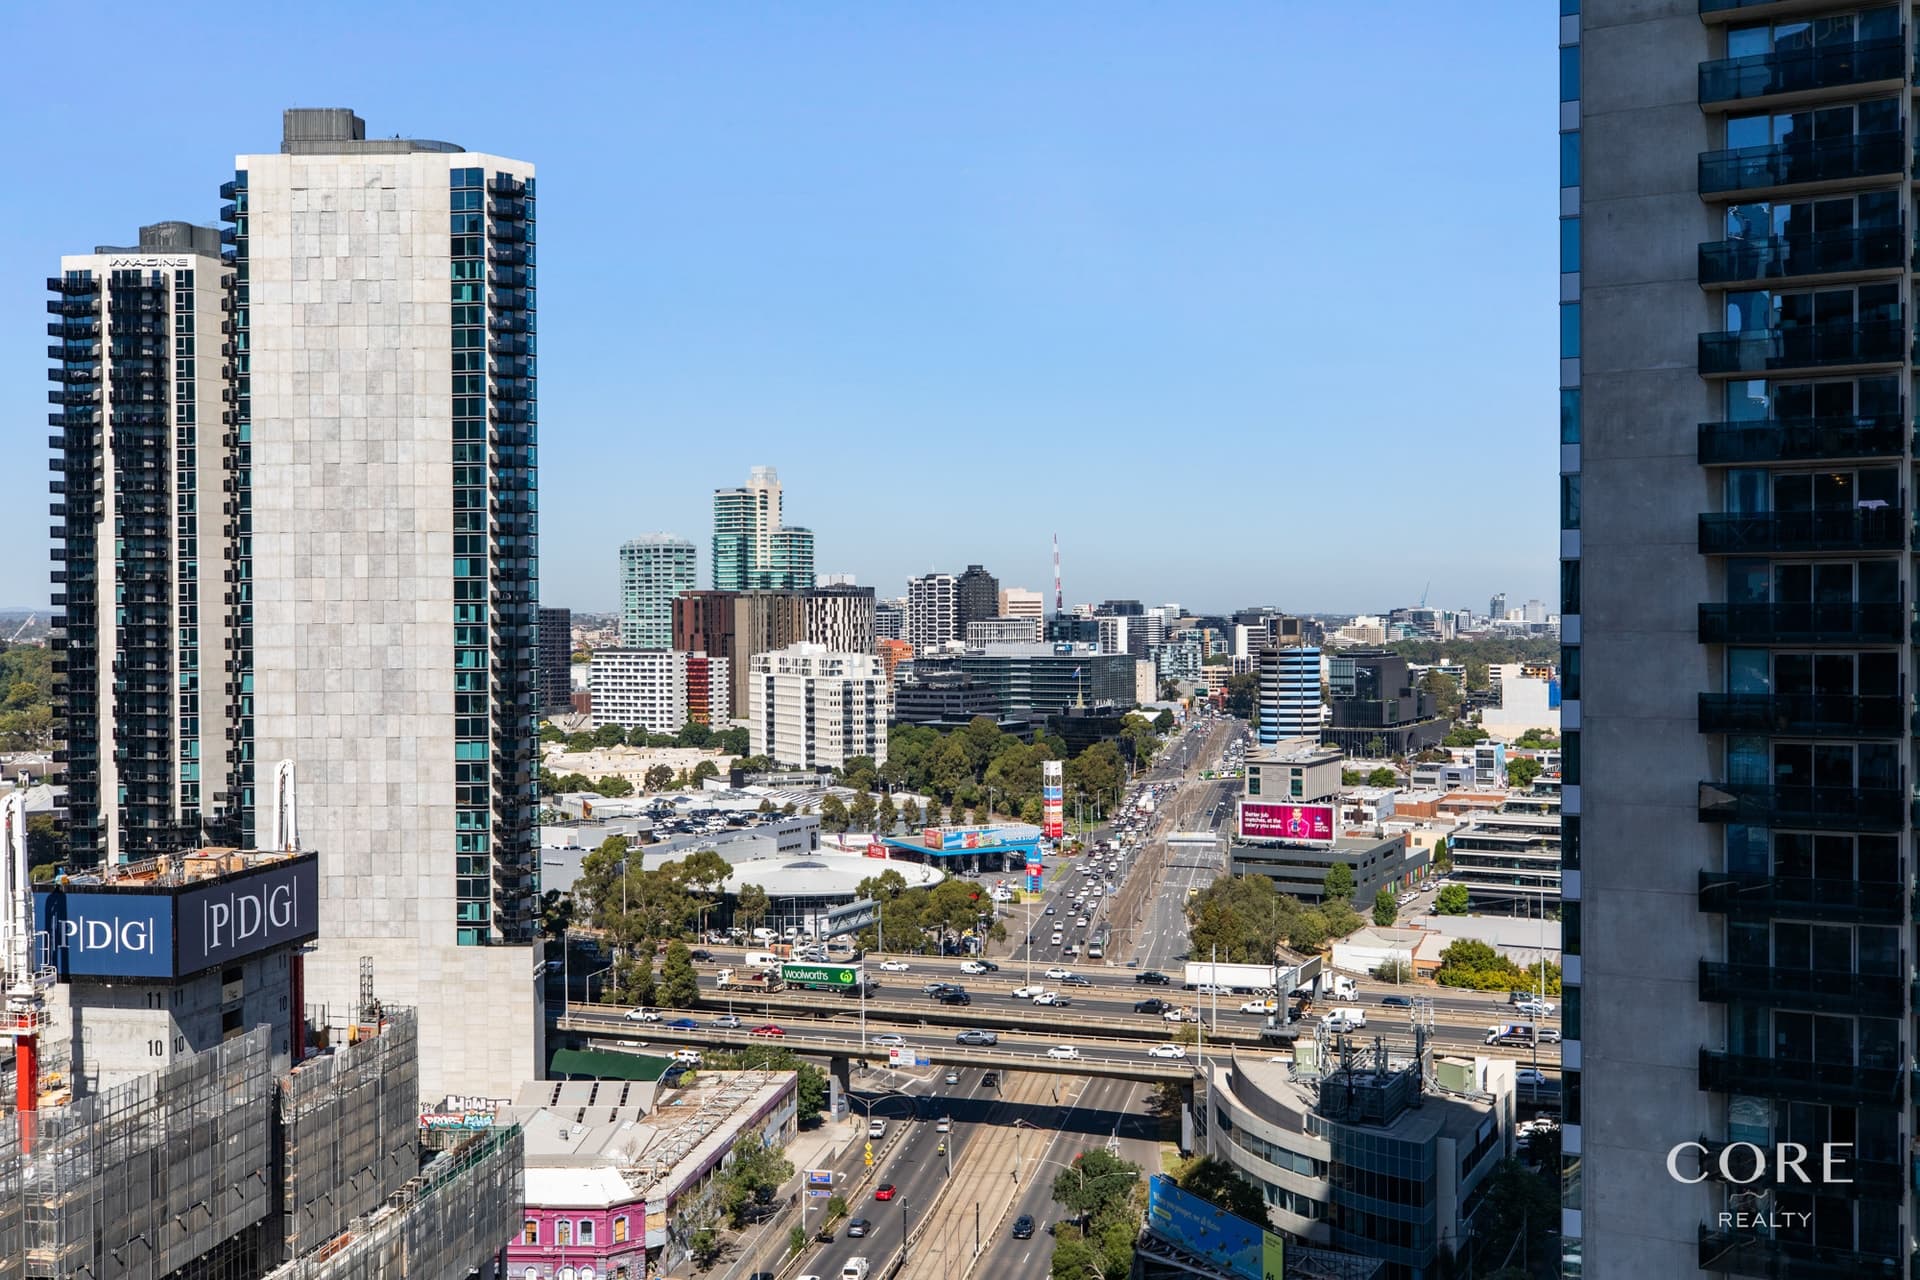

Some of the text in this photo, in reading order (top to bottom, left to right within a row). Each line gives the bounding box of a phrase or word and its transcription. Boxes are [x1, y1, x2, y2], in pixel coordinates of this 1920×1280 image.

[784, 969, 829, 980] Woolworths
[147, 992, 161, 1009] 11
[148, 1040, 163, 1057] 10
[174, 1036, 185, 1054] 10
